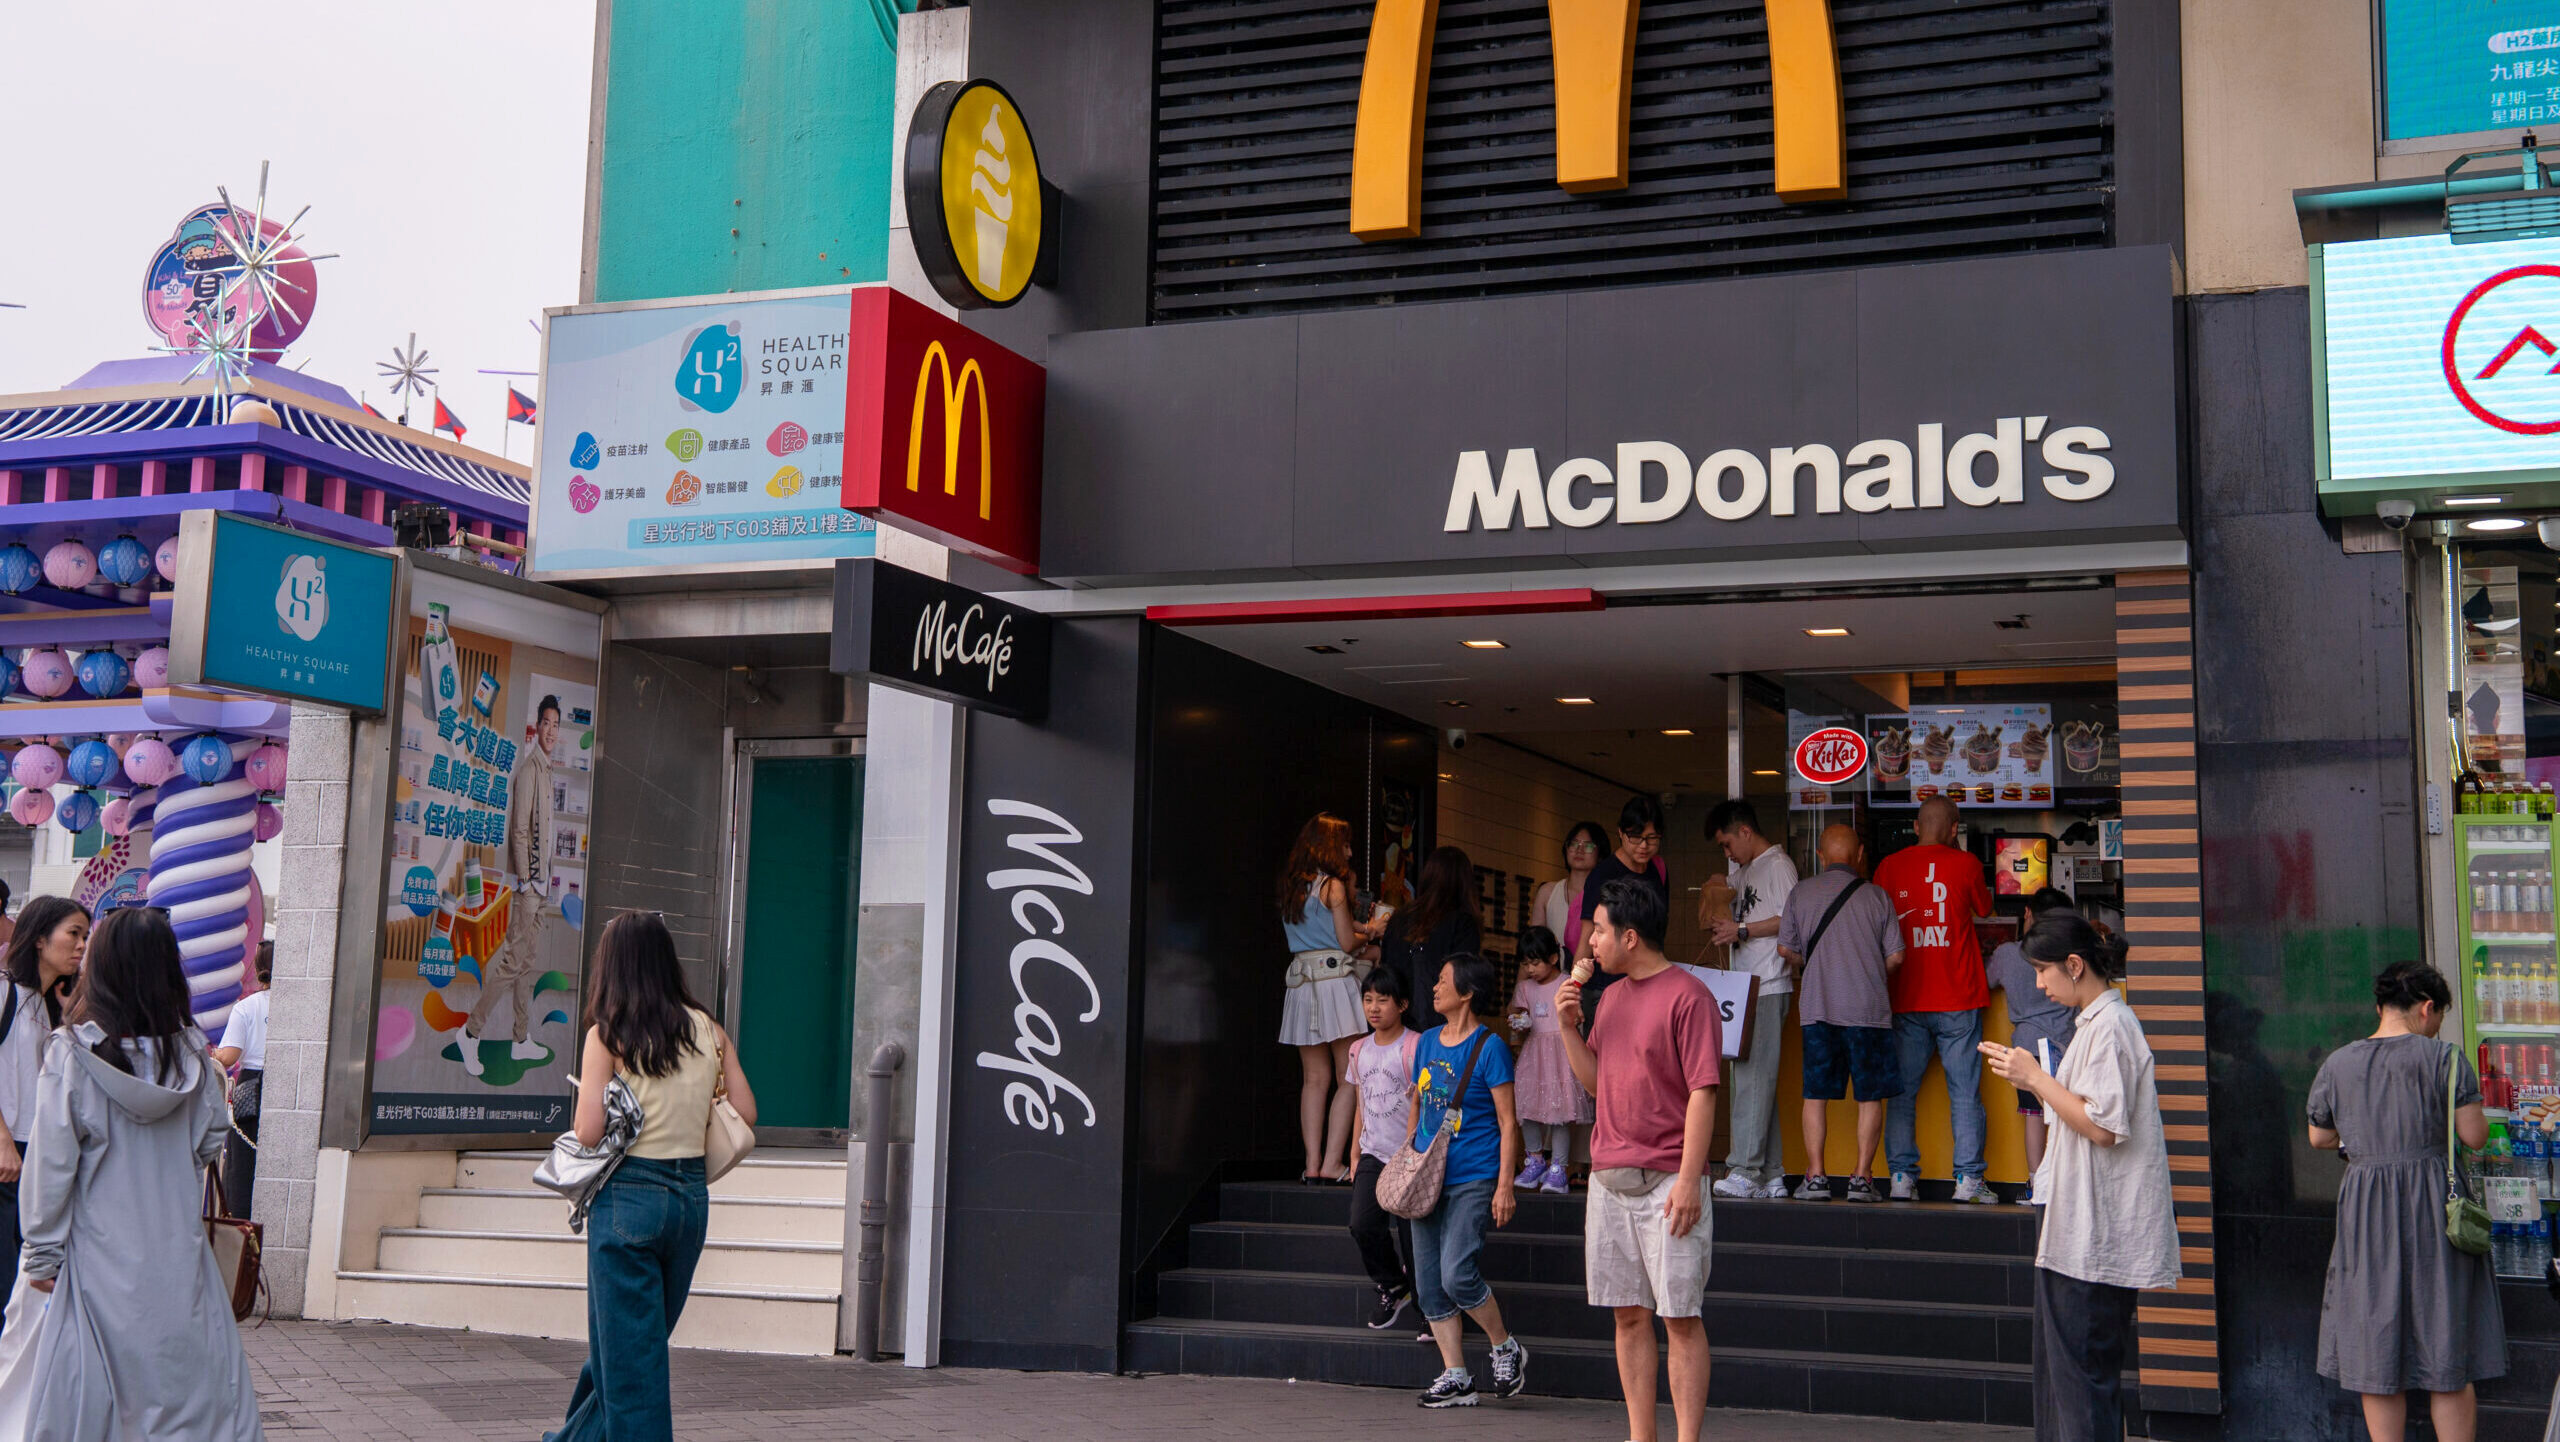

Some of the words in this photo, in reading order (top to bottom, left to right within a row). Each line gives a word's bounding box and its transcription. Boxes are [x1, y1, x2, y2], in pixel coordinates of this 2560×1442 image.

[762, 333, 850, 355] HEALTH
[606, 443, 649, 457] 疫苗注射
[708, 437, 751, 452] 健康產品
[1443, 415, 2116, 533] McDonald's
[604, 486, 646, 501] 護牙美齒
[705, 480, 749, 495] 智能醫健
[912, 600, 1014, 692] McCafé
[246, 644, 299, 664] HEALTHY
[304, 656, 351, 675] SQUARE
[437, 704, 518, 775] 各大健康
[1823, 732, 1840, 740] Made
[1840, 733, 1854, 741] with
[1811, 740, 1857, 772] KitKat
[427, 753, 510, 812] 品牌產品
[423, 800, 507, 848] 任你選擇
[1899, 890, 1909, 898] 20
[1924, 909, 1934, 917] 25
[1912, 926, 1950, 948] DAY.
[418, 963, 457, 977] 折扣及優惠
[976, 798, 1102, 1137] McCafé
